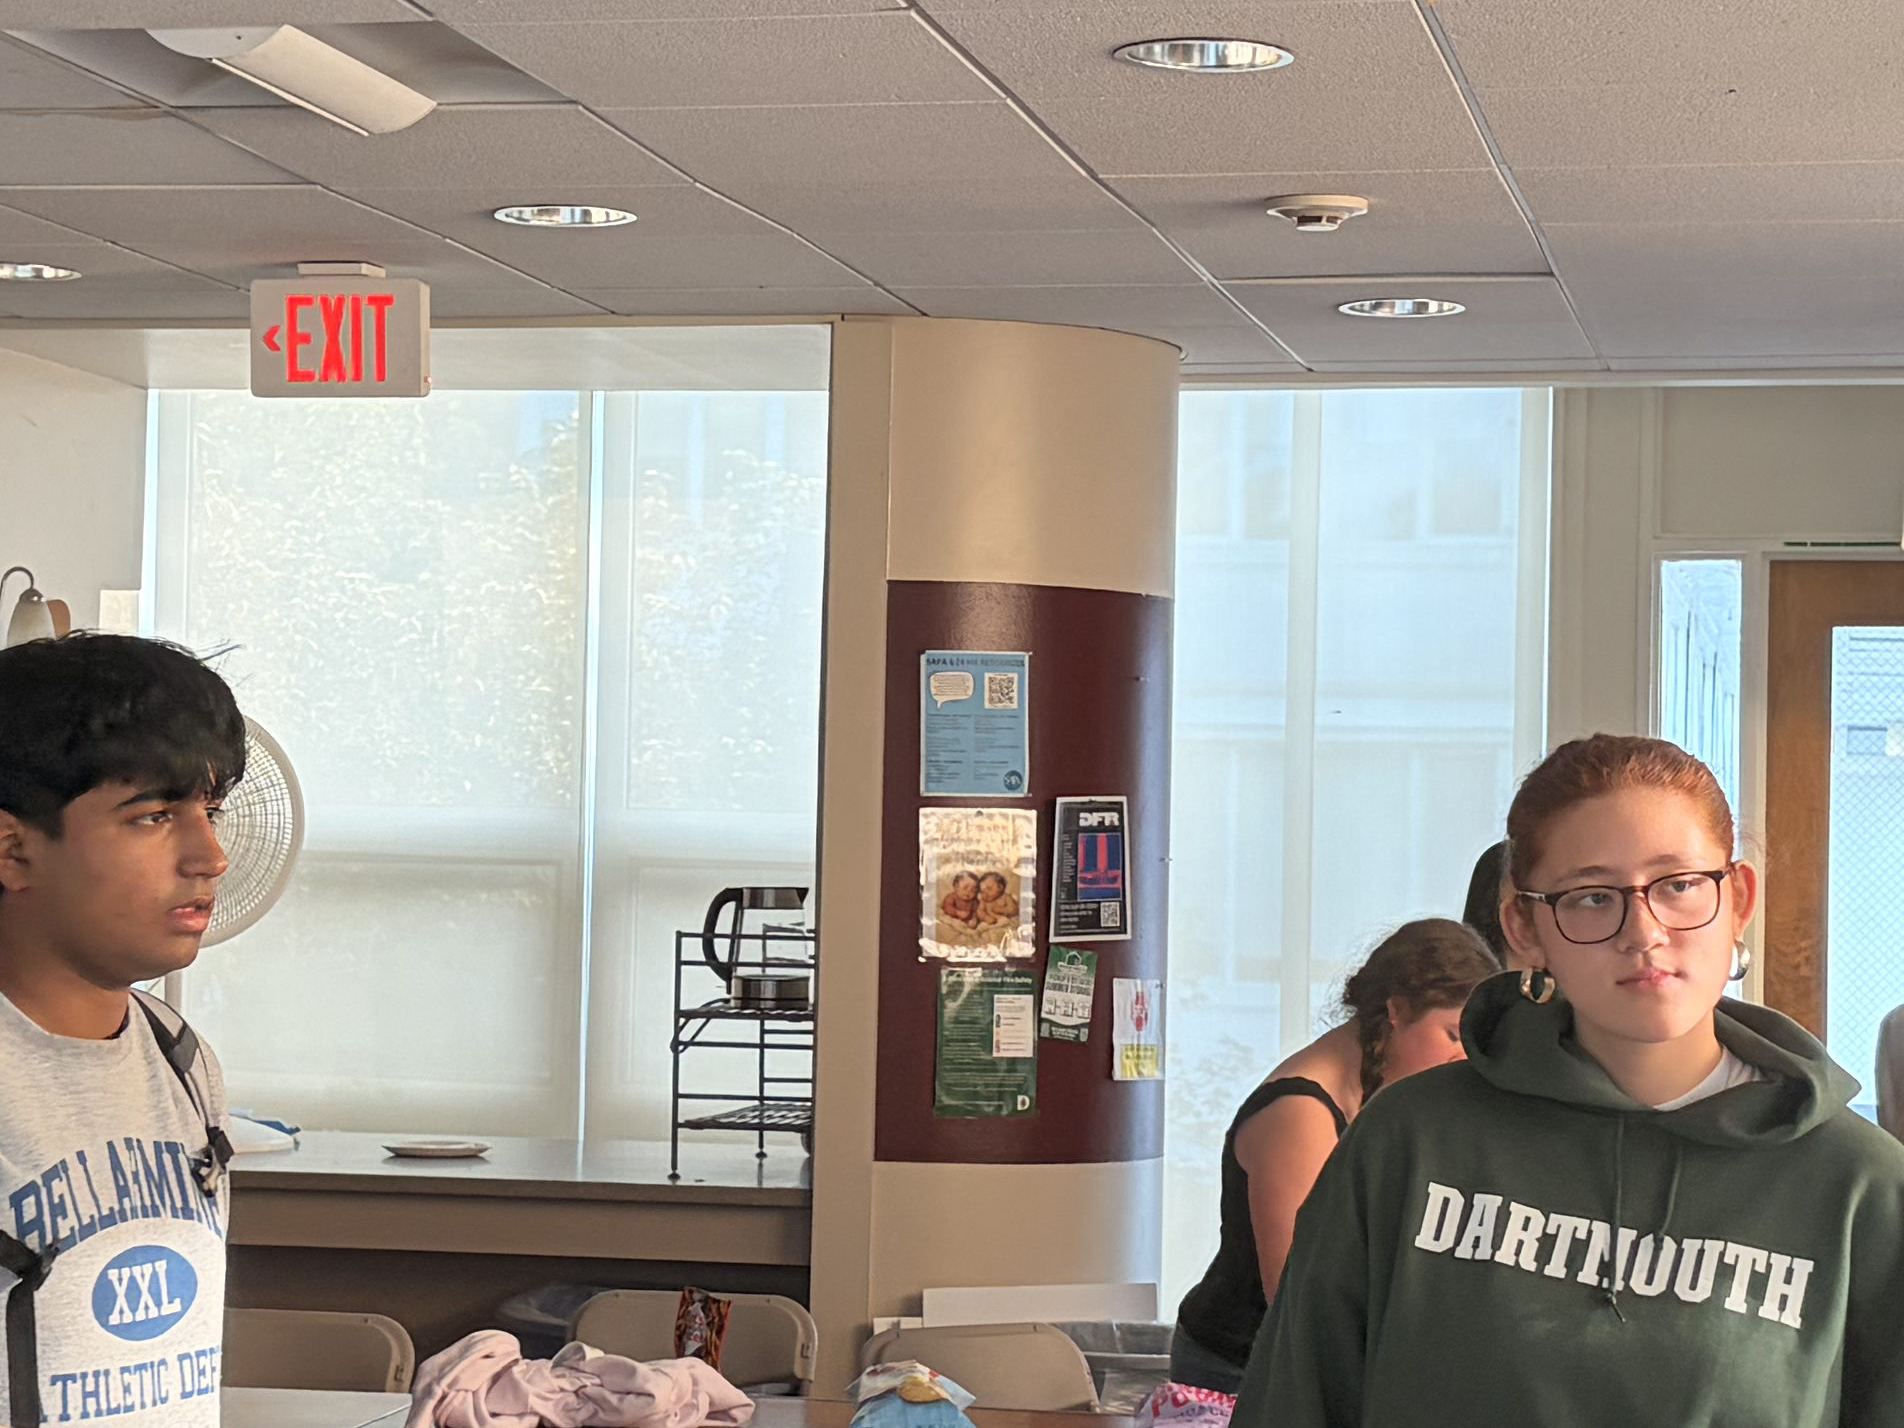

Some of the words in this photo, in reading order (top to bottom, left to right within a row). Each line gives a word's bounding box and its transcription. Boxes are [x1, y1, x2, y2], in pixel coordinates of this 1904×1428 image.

[284, 294, 396, 383] EXIT
[1079, 811, 1120, 827] DFR
[1413, 1181, 1815, 1330] DARTMOUTH
[108, 1259, 183, 1327] XXL
[39, 1357, 170, 1425] THLETIC
